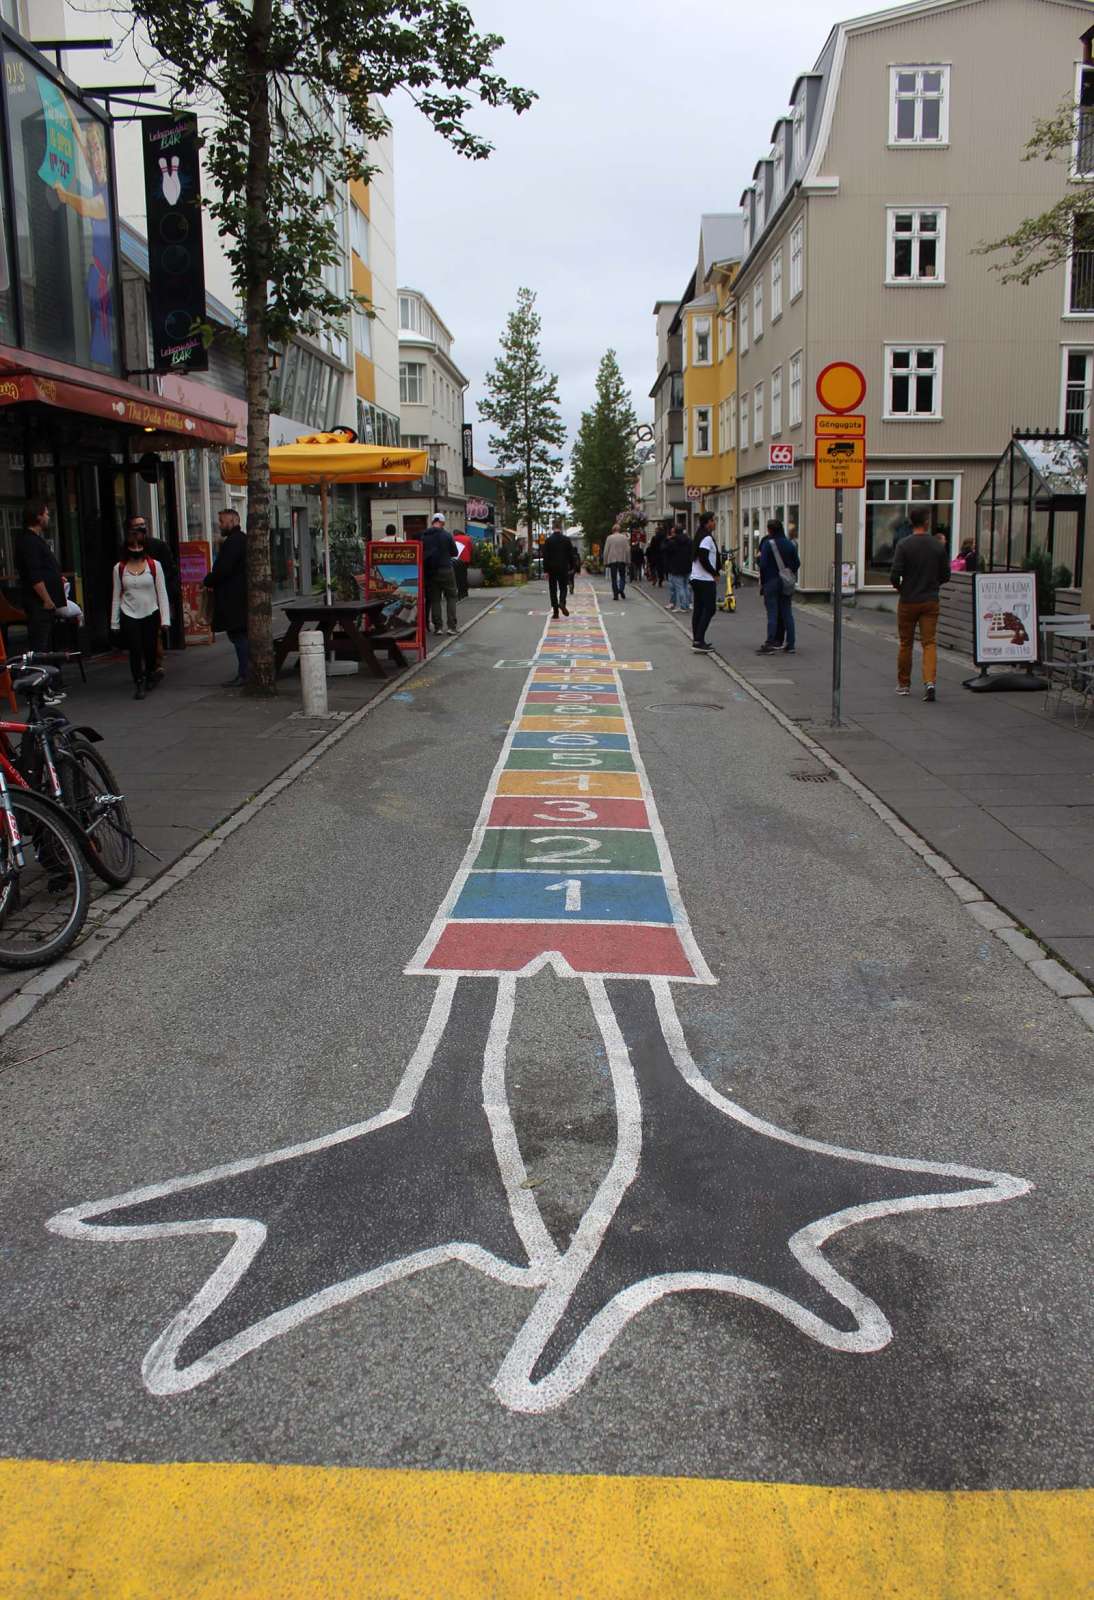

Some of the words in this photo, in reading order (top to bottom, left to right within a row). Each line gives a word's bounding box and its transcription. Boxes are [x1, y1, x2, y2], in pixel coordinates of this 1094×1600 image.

[172, 348, 192, 365] BAR
[549, 682, 605, 691] 10
[555, 693, 593, 701] 9
[553, 704, 597, 714] 8
[552, 719, 591, 728] 7
[547, 733, 599, 746] 6
[549, 753, 603, 767] 5
[537, 774, 602, 791] 4
[532, 800, 598, 822] 3
[524, 835, 612, 863] 2
[544, 879, 582, 911] 1
